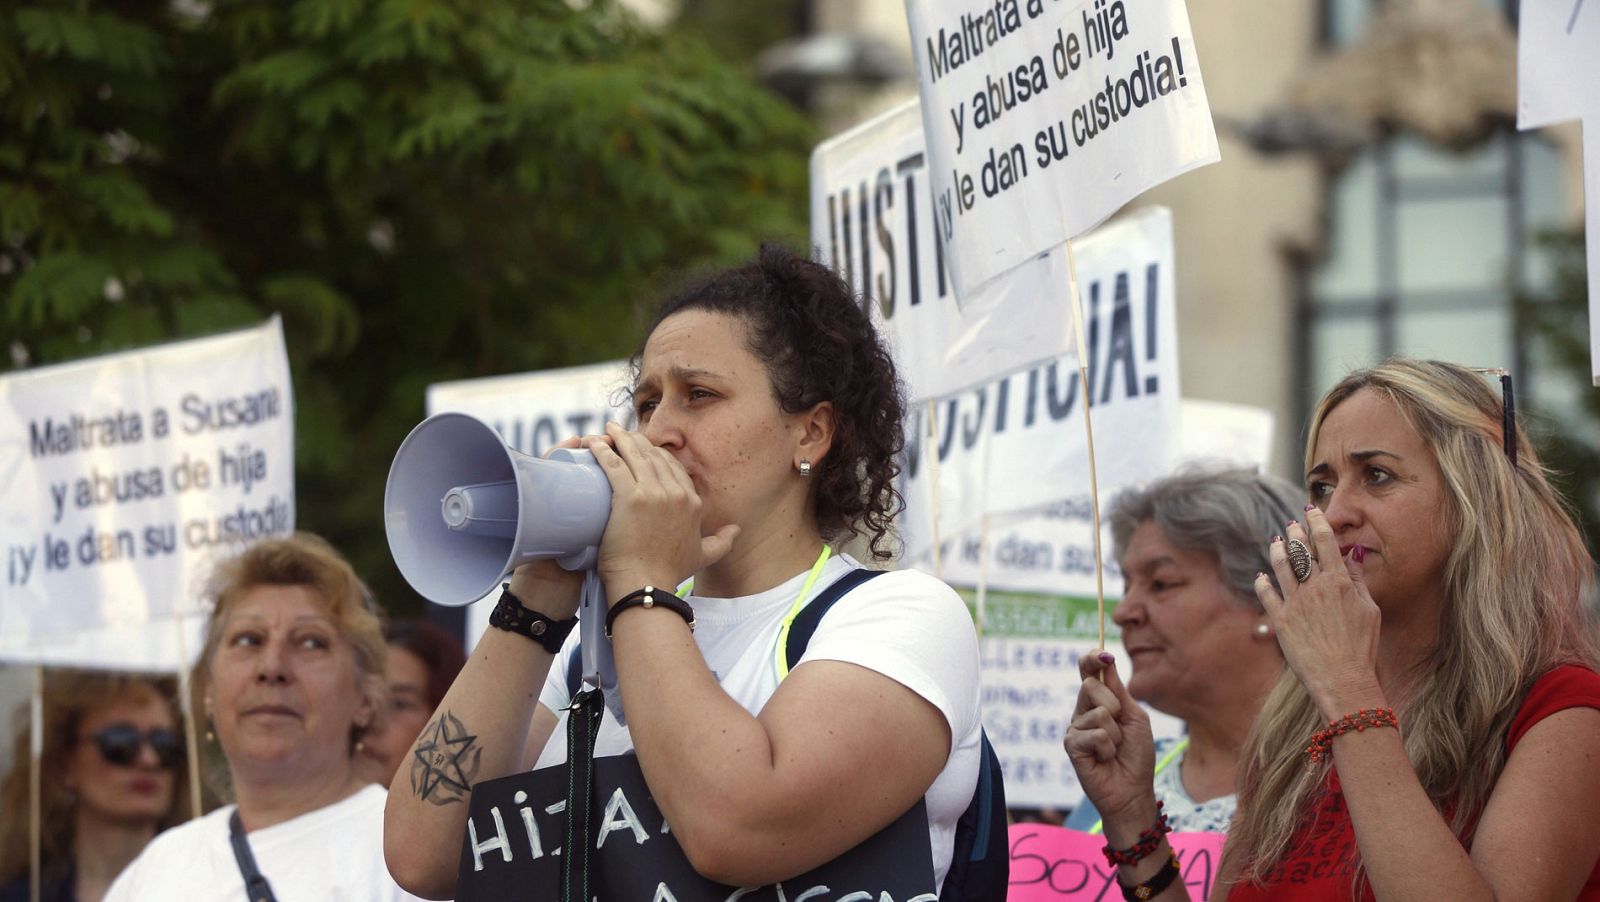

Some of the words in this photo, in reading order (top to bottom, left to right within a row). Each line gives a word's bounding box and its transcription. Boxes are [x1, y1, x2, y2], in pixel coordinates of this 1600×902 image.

[926, 0, 1022, 83] Maltrata
[950, 102, 965, 154] y
[972, 55, 1048, 129] abusa
[1052, 28, 1081, 80] de
[1082, 0, 1129, 60] hija
[953, 169, 975, 215] le
[981, 148, 1028, 198] dan
[1034, 121, 1068, 168] su
[1071, 37, 1187, 147] custodia!
[30, 409, 143, 458] Maltrata
[152, 408, 169, 438] a
[52, 482, 67, 523] y
[75, 466, 163, 508] abusa
[172, 452, 211, 494] de
[219, 444, 266, 494] hija
[45, 532, 70, 571] le
[79, 524, 135, 566] dan
[145, 521, 175, 555] su
